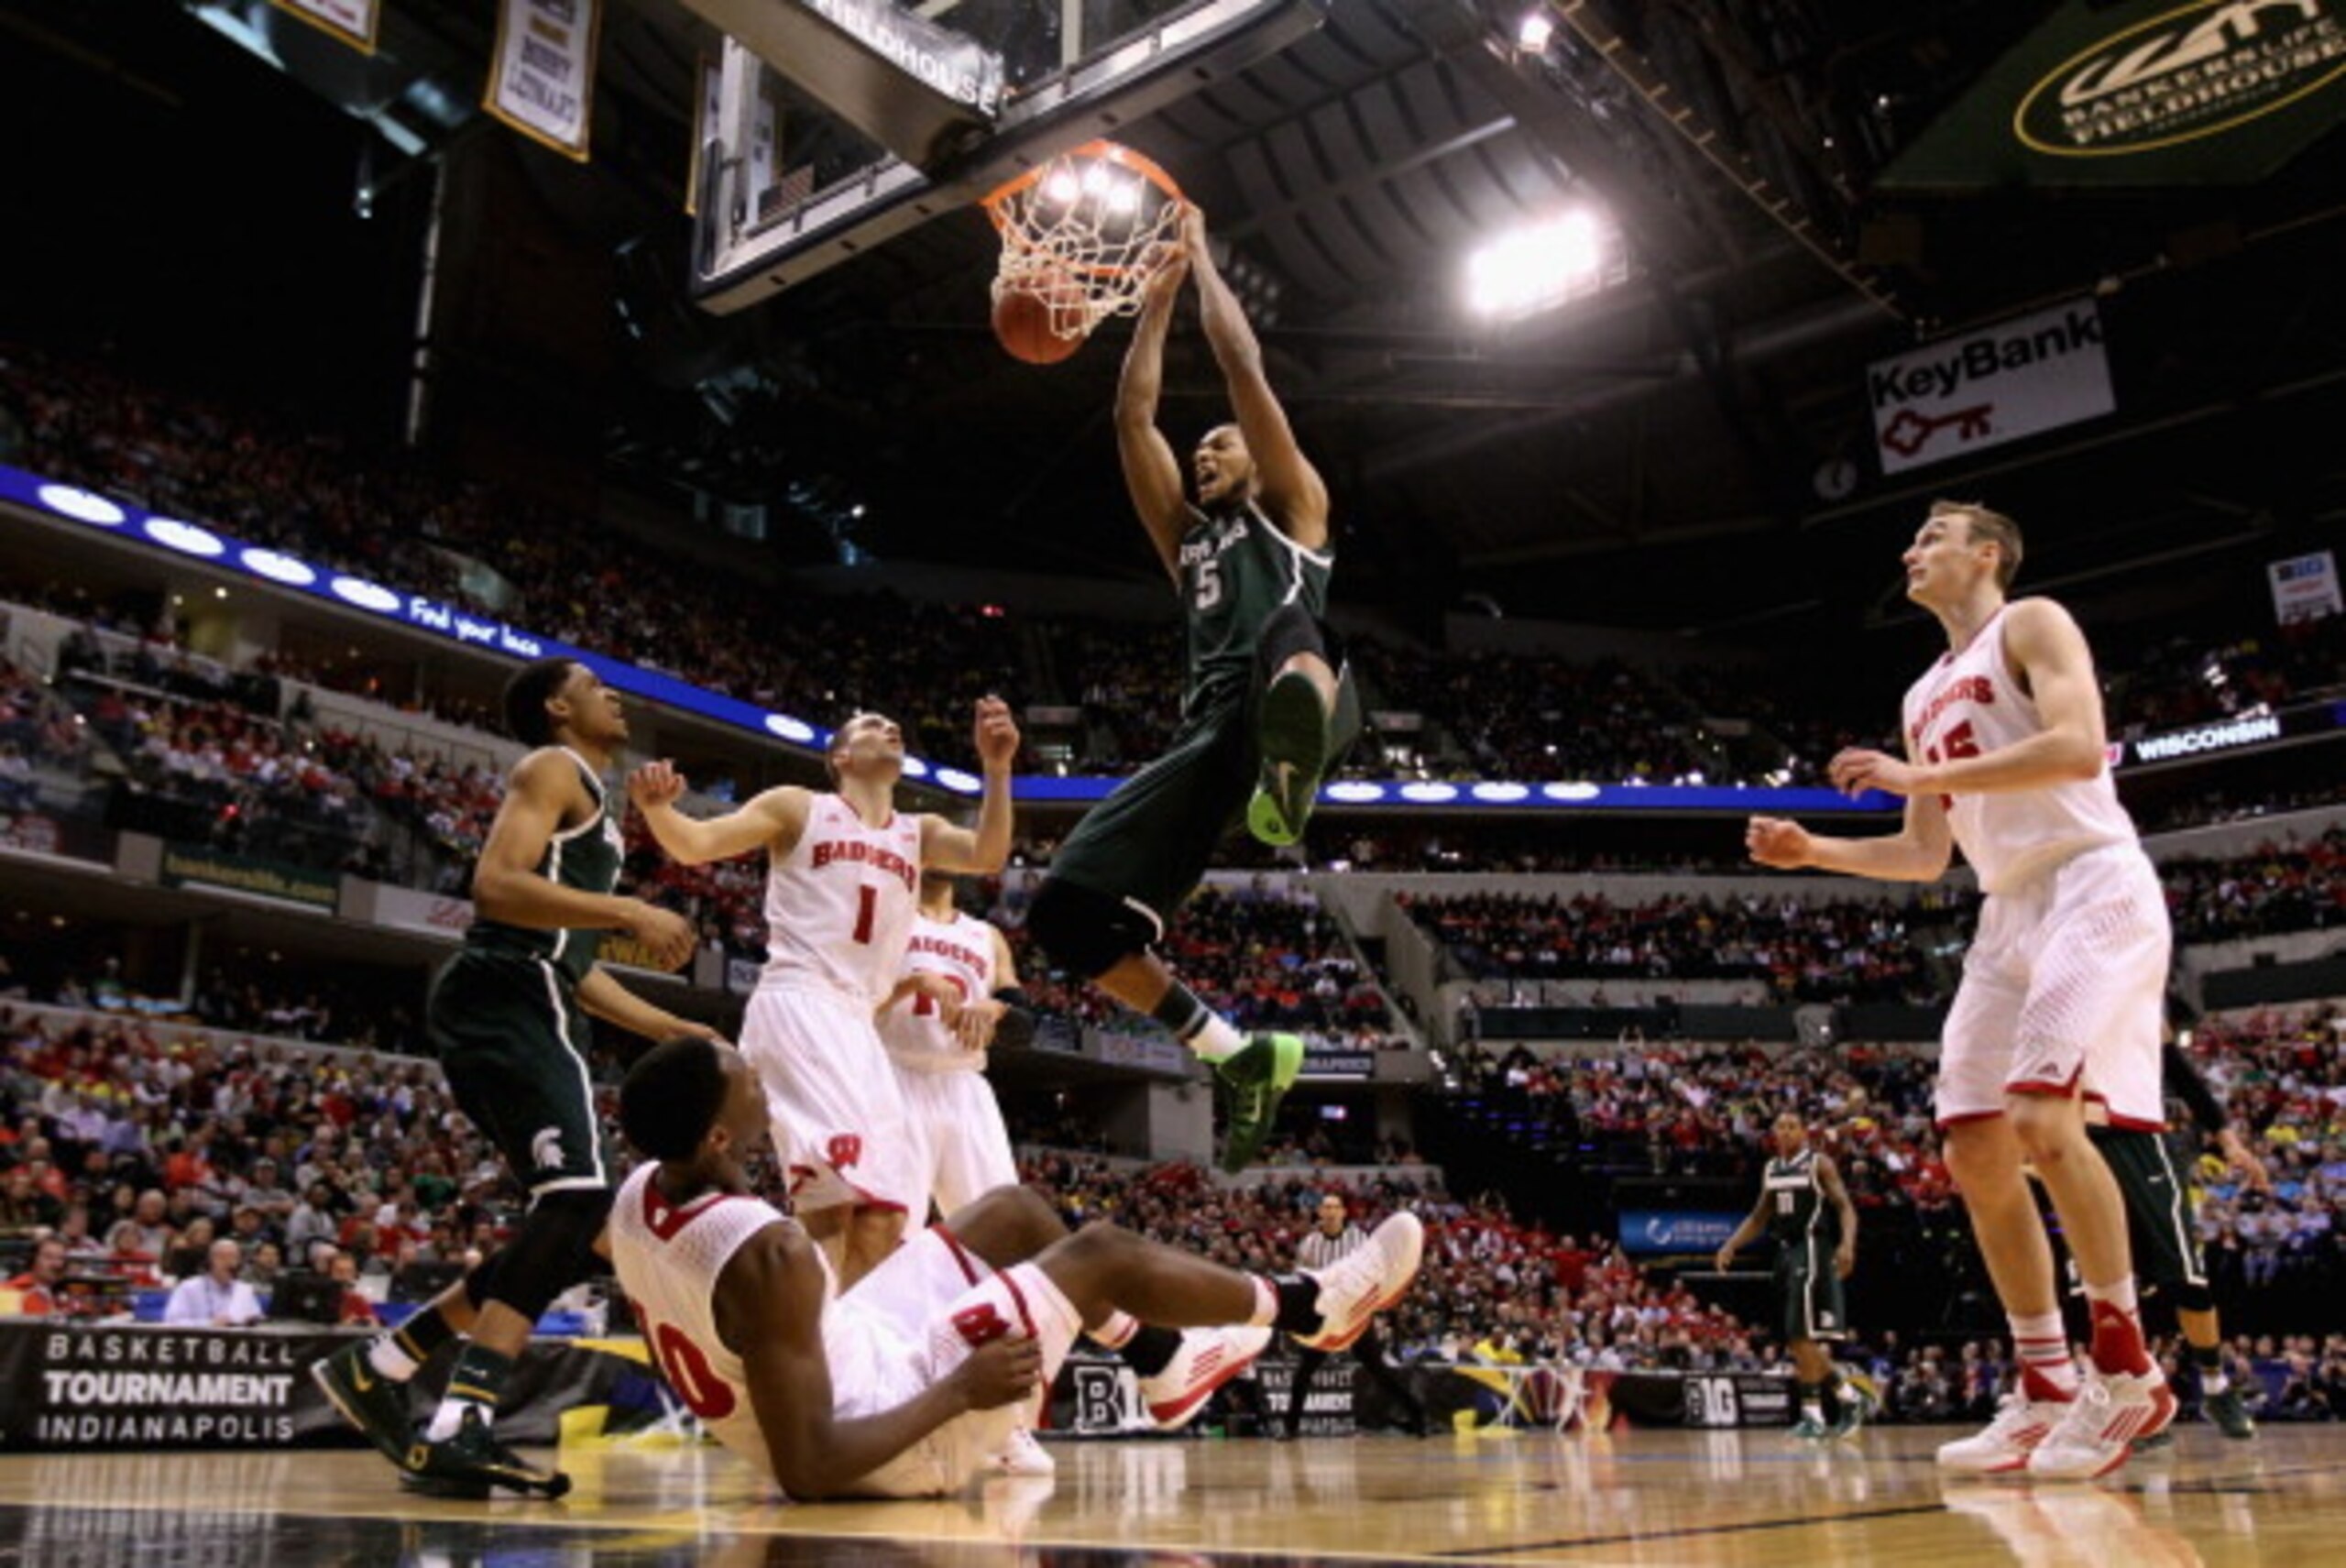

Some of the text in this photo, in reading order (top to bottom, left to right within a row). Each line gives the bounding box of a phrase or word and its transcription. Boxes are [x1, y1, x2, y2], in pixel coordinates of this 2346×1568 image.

[2063, 47, 2258, 125] BANKERS
[2261, 17, 2339, 57] LIFE
[1871, 311, 2106, 408] KeyBank
[1196, 559, 1221, 609] 5
[411, 596, 450, 630] Find
[455, 615, 498, 643] your
[2136, 717, 2280, 762] WISCONSIN
[852, 883, 877, 946] 1
[47, 1334, 295, 1365] BASKETBALL
[44, 1371, 294, 1405] TOURNAMENT
[38, 1416, 295, 1440] INDIANAPOLIS
